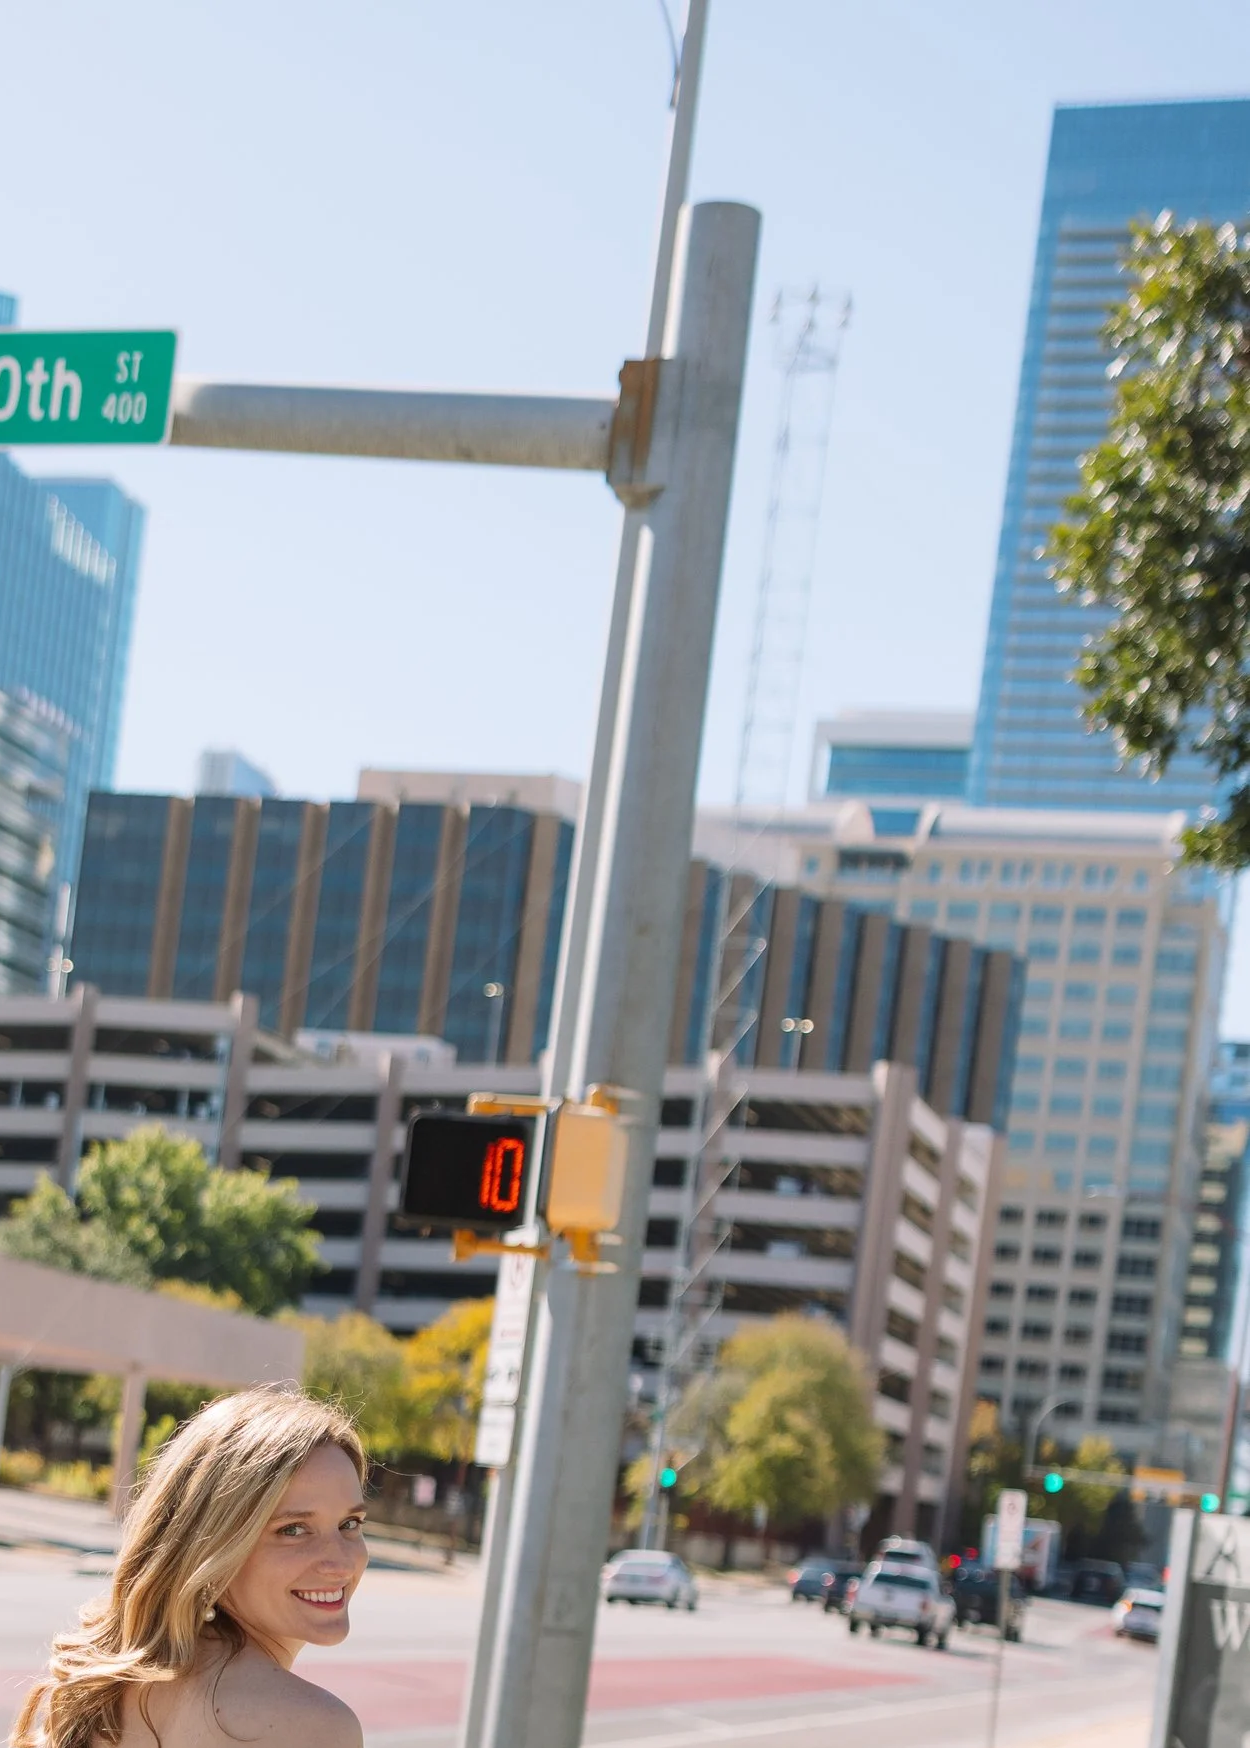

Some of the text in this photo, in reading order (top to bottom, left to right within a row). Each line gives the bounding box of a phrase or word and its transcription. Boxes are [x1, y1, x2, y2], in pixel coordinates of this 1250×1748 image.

[115, 351, 144, 383] ST
[101, 392, 148, 424] 400
[479, 1137, 525, 1213] 10
